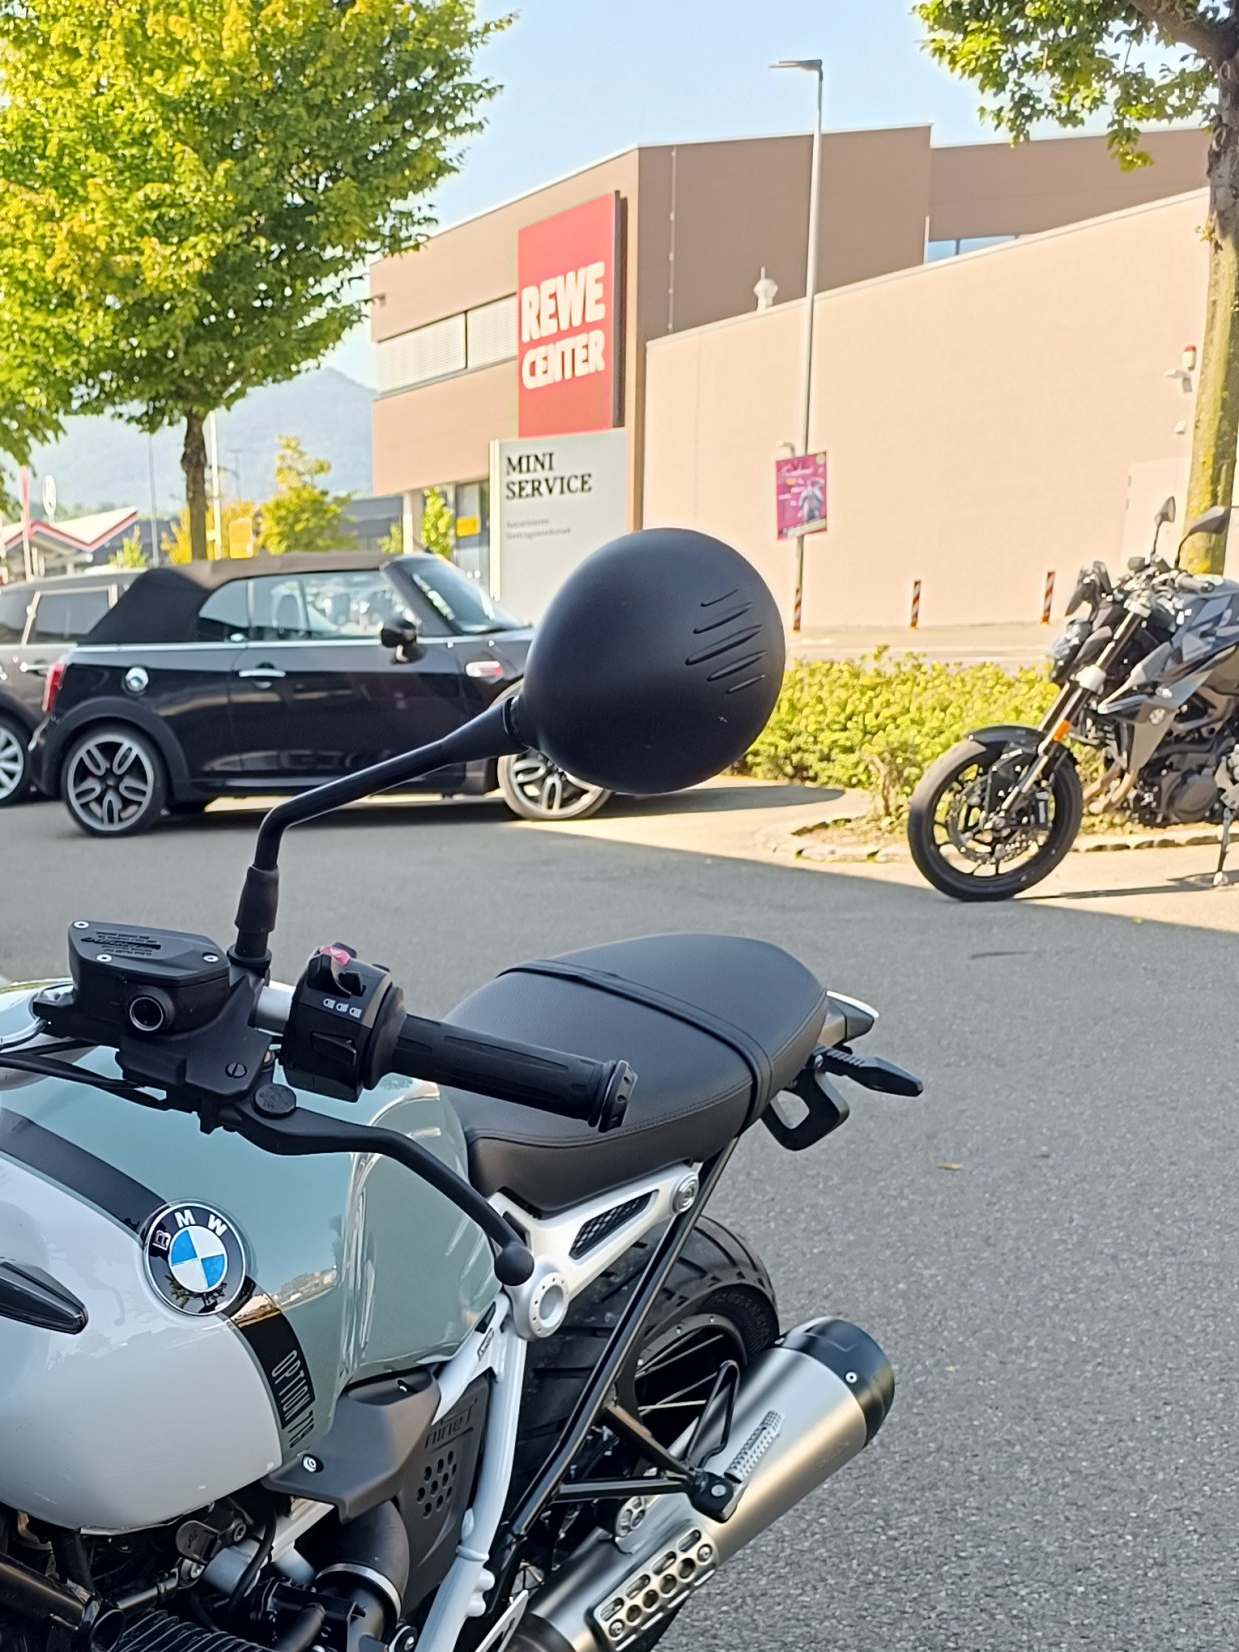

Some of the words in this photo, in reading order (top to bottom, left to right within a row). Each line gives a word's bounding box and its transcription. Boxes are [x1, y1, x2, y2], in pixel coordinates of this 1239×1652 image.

[521, 261, 605, 343] REWE
[521, 329, 605, 390] CENTER
[505, 473, 592, 500] SERVICE
[506, 452, 554, 476] MINI
[152, 1209, 228, 1251] BMW
[271, 1349, 312, 1421] OPTION
